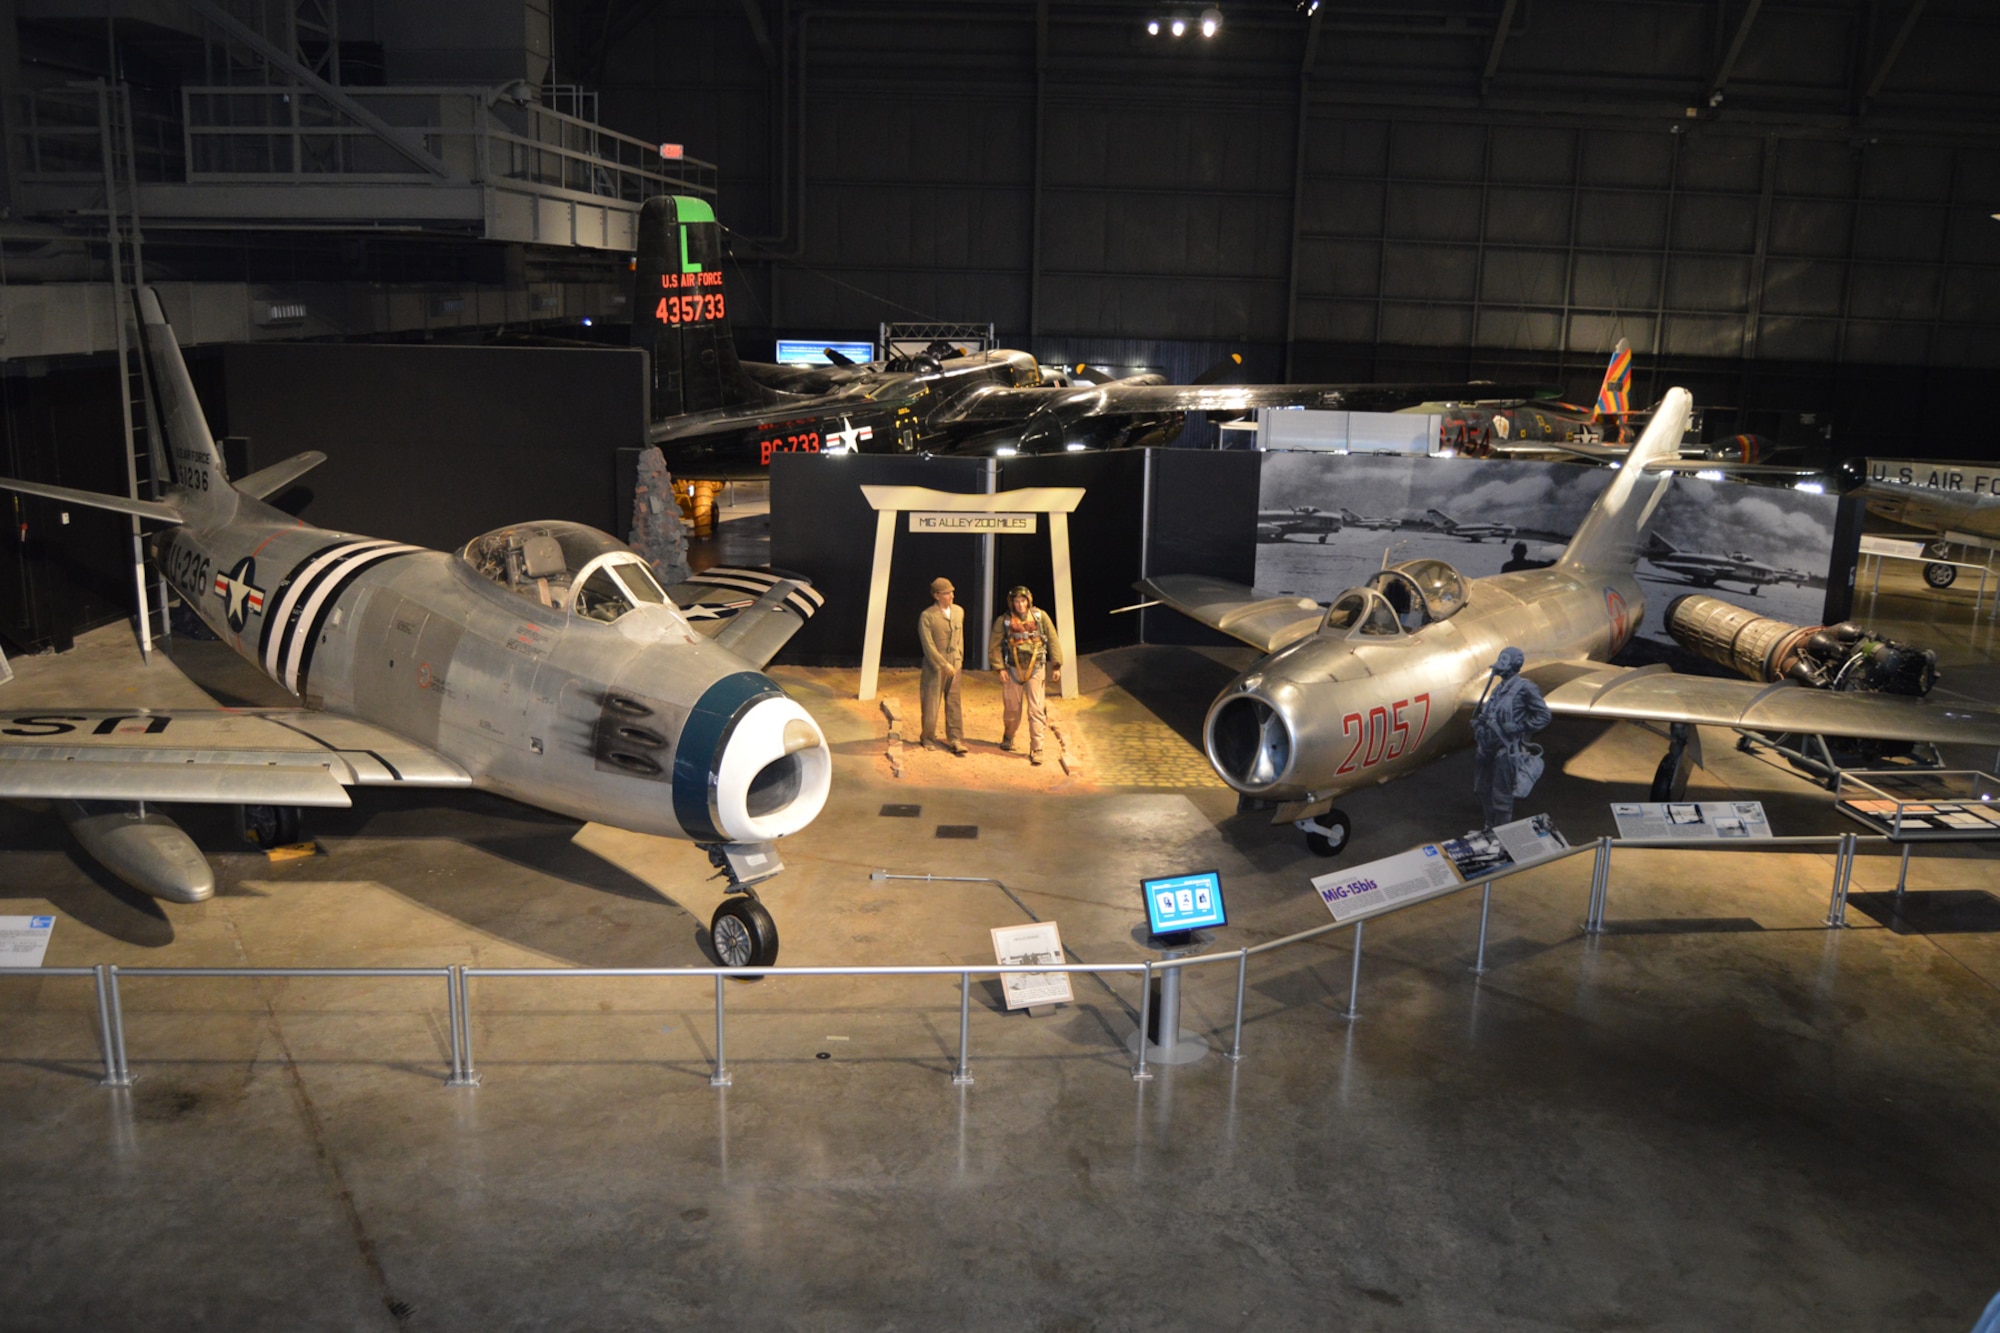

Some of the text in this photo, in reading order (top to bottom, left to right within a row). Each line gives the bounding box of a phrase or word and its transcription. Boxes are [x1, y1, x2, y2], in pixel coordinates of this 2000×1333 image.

[680, 225, 702, 273] L
[681, 273, 696, 288] AIR
[698, 272, 723, 286] FORCE
[655, 293, 725, 324] 435733
[191, 450, 211, 465] FORCE
[1928, 471, 1963, 490] AIR
[919, 517, 1028, 529] MIG ALLEY 200 MILES
[1334, 692, 1430, 777] 2057
[1322, 878, 1378, 903] MiG-15bis
